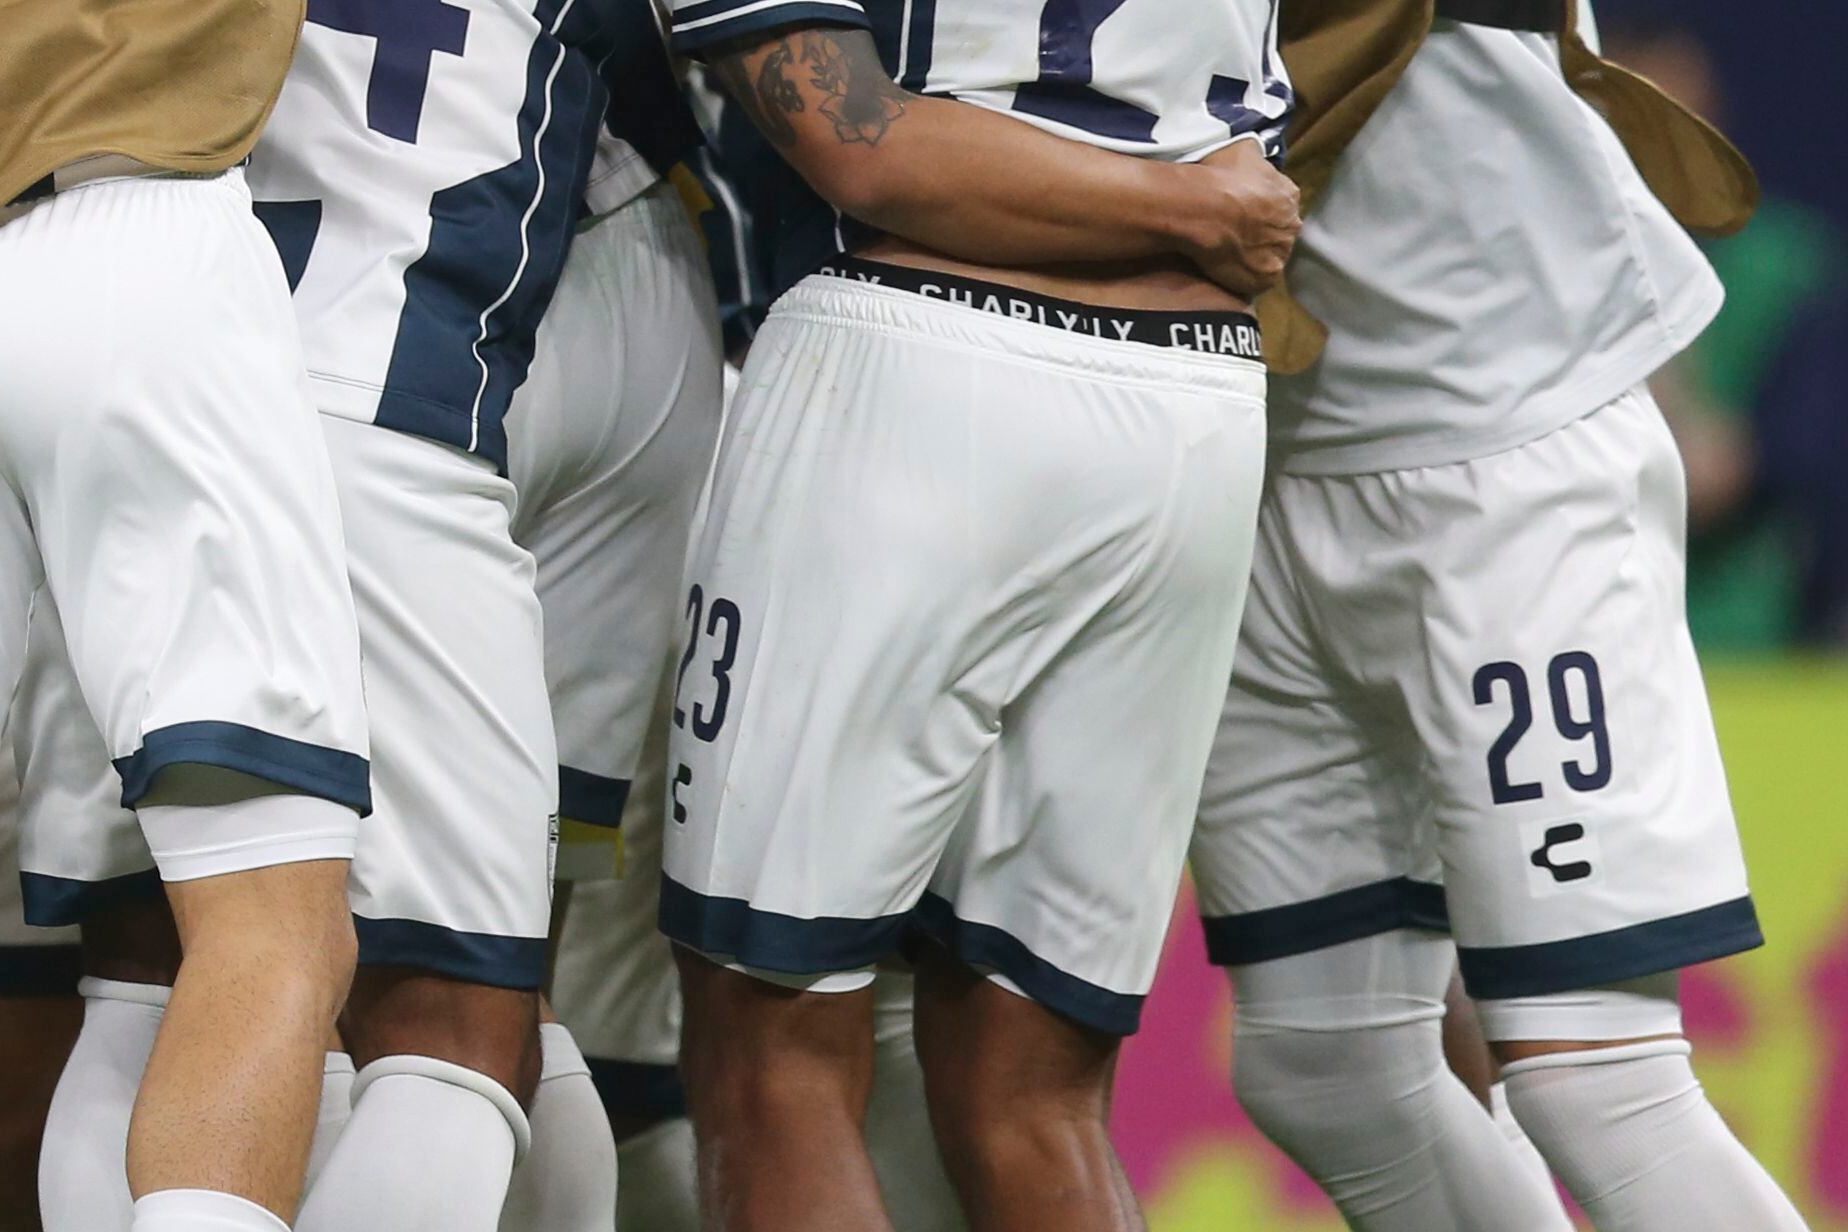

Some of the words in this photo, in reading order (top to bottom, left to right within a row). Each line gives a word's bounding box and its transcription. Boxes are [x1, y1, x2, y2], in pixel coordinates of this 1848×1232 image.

[1169, 322, 1262, 356] CHARL
[674, 583, 742, 743] 23
[1472, 650, 1613, 805] 29
